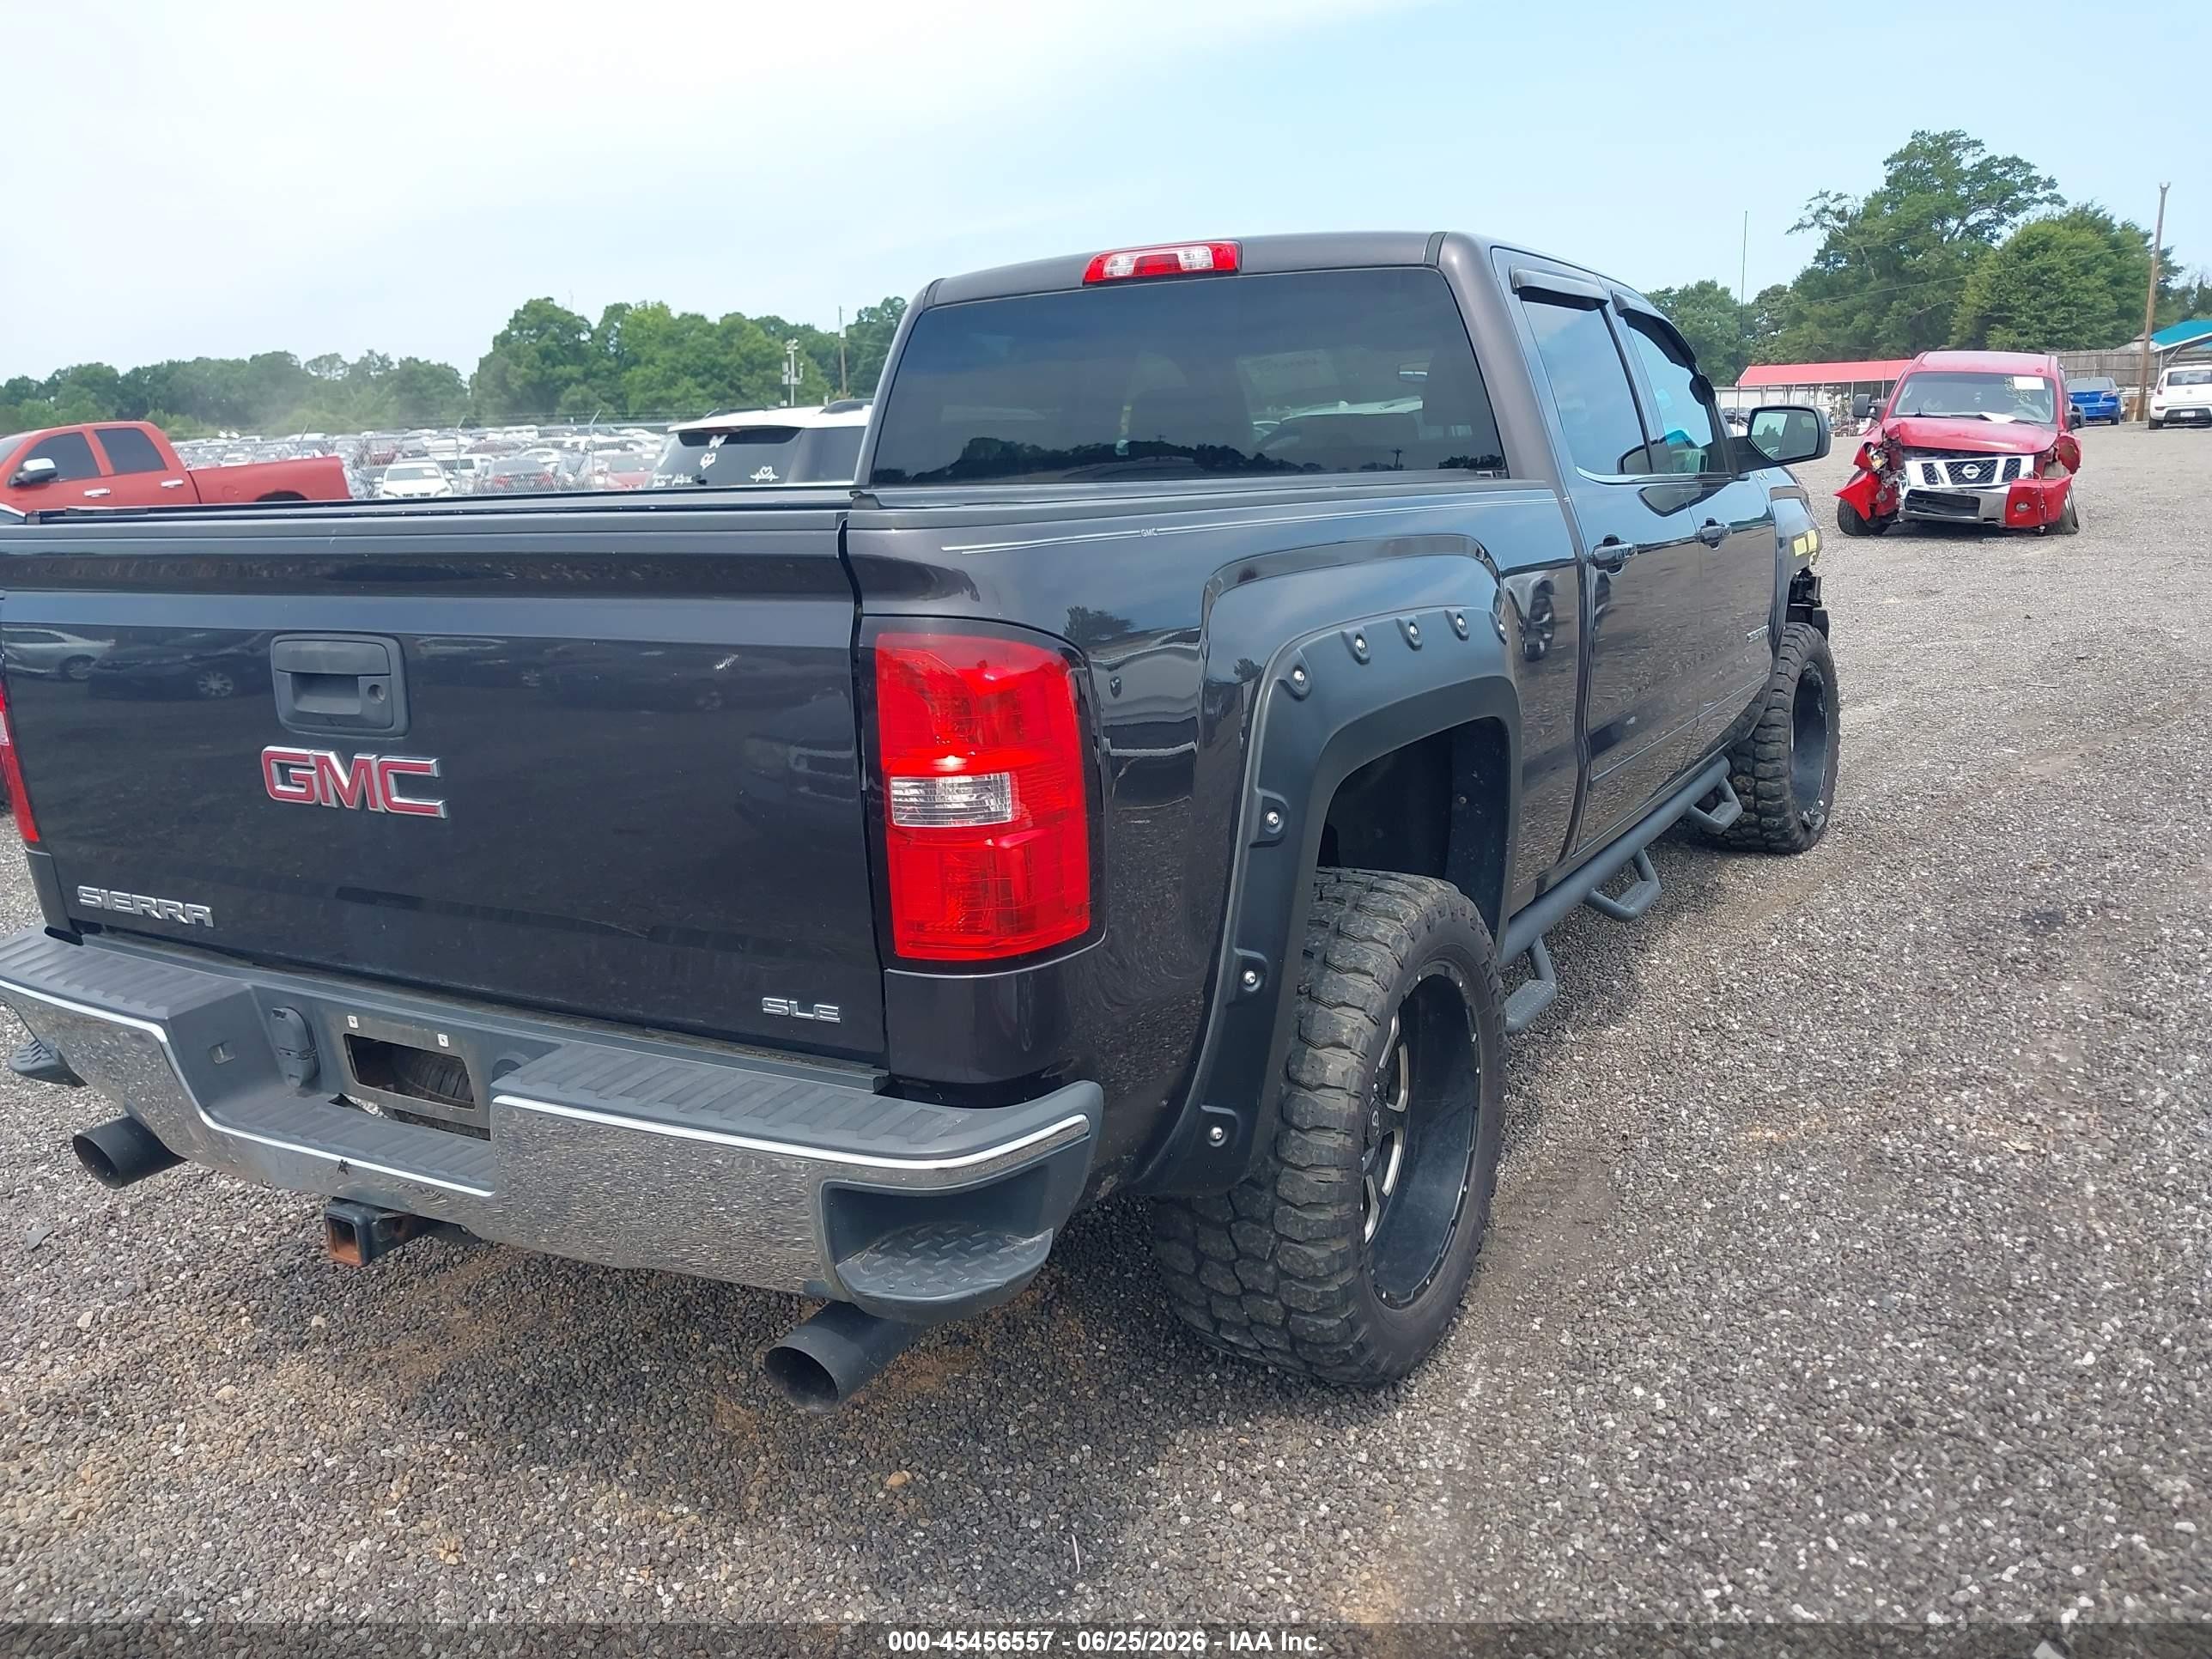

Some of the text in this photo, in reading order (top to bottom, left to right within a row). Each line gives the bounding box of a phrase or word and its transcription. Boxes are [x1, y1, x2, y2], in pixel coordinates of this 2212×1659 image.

[1140, 528, 1158, 538] GMC
[261, 745, 447, 819] GMC
[77, 885, 214, 927] SIERRA
[762, 997, 842, 1024] SLE
